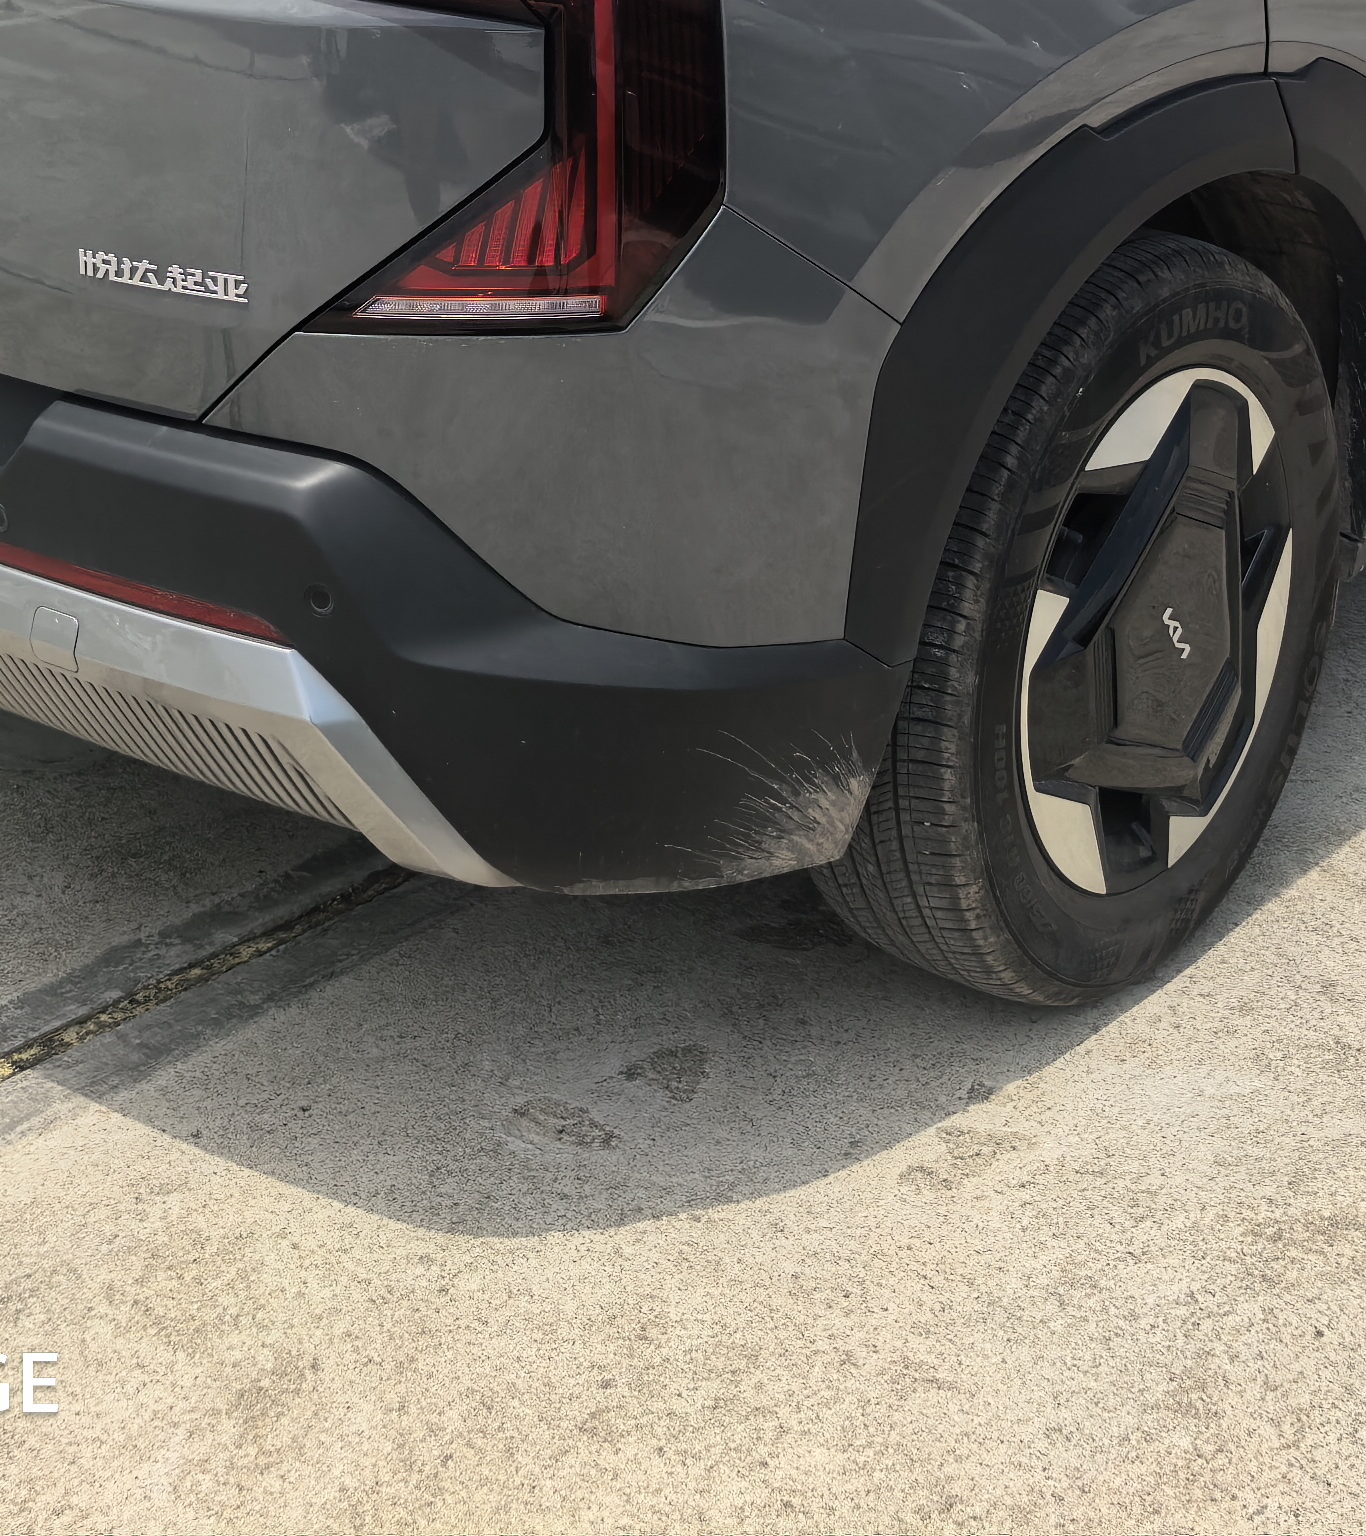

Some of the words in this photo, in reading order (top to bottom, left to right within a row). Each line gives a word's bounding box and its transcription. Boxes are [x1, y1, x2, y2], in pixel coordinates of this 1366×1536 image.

[78, 248, 249, 303] 悦达起亚
[1138, 299, 1250, 367] KUMHO
